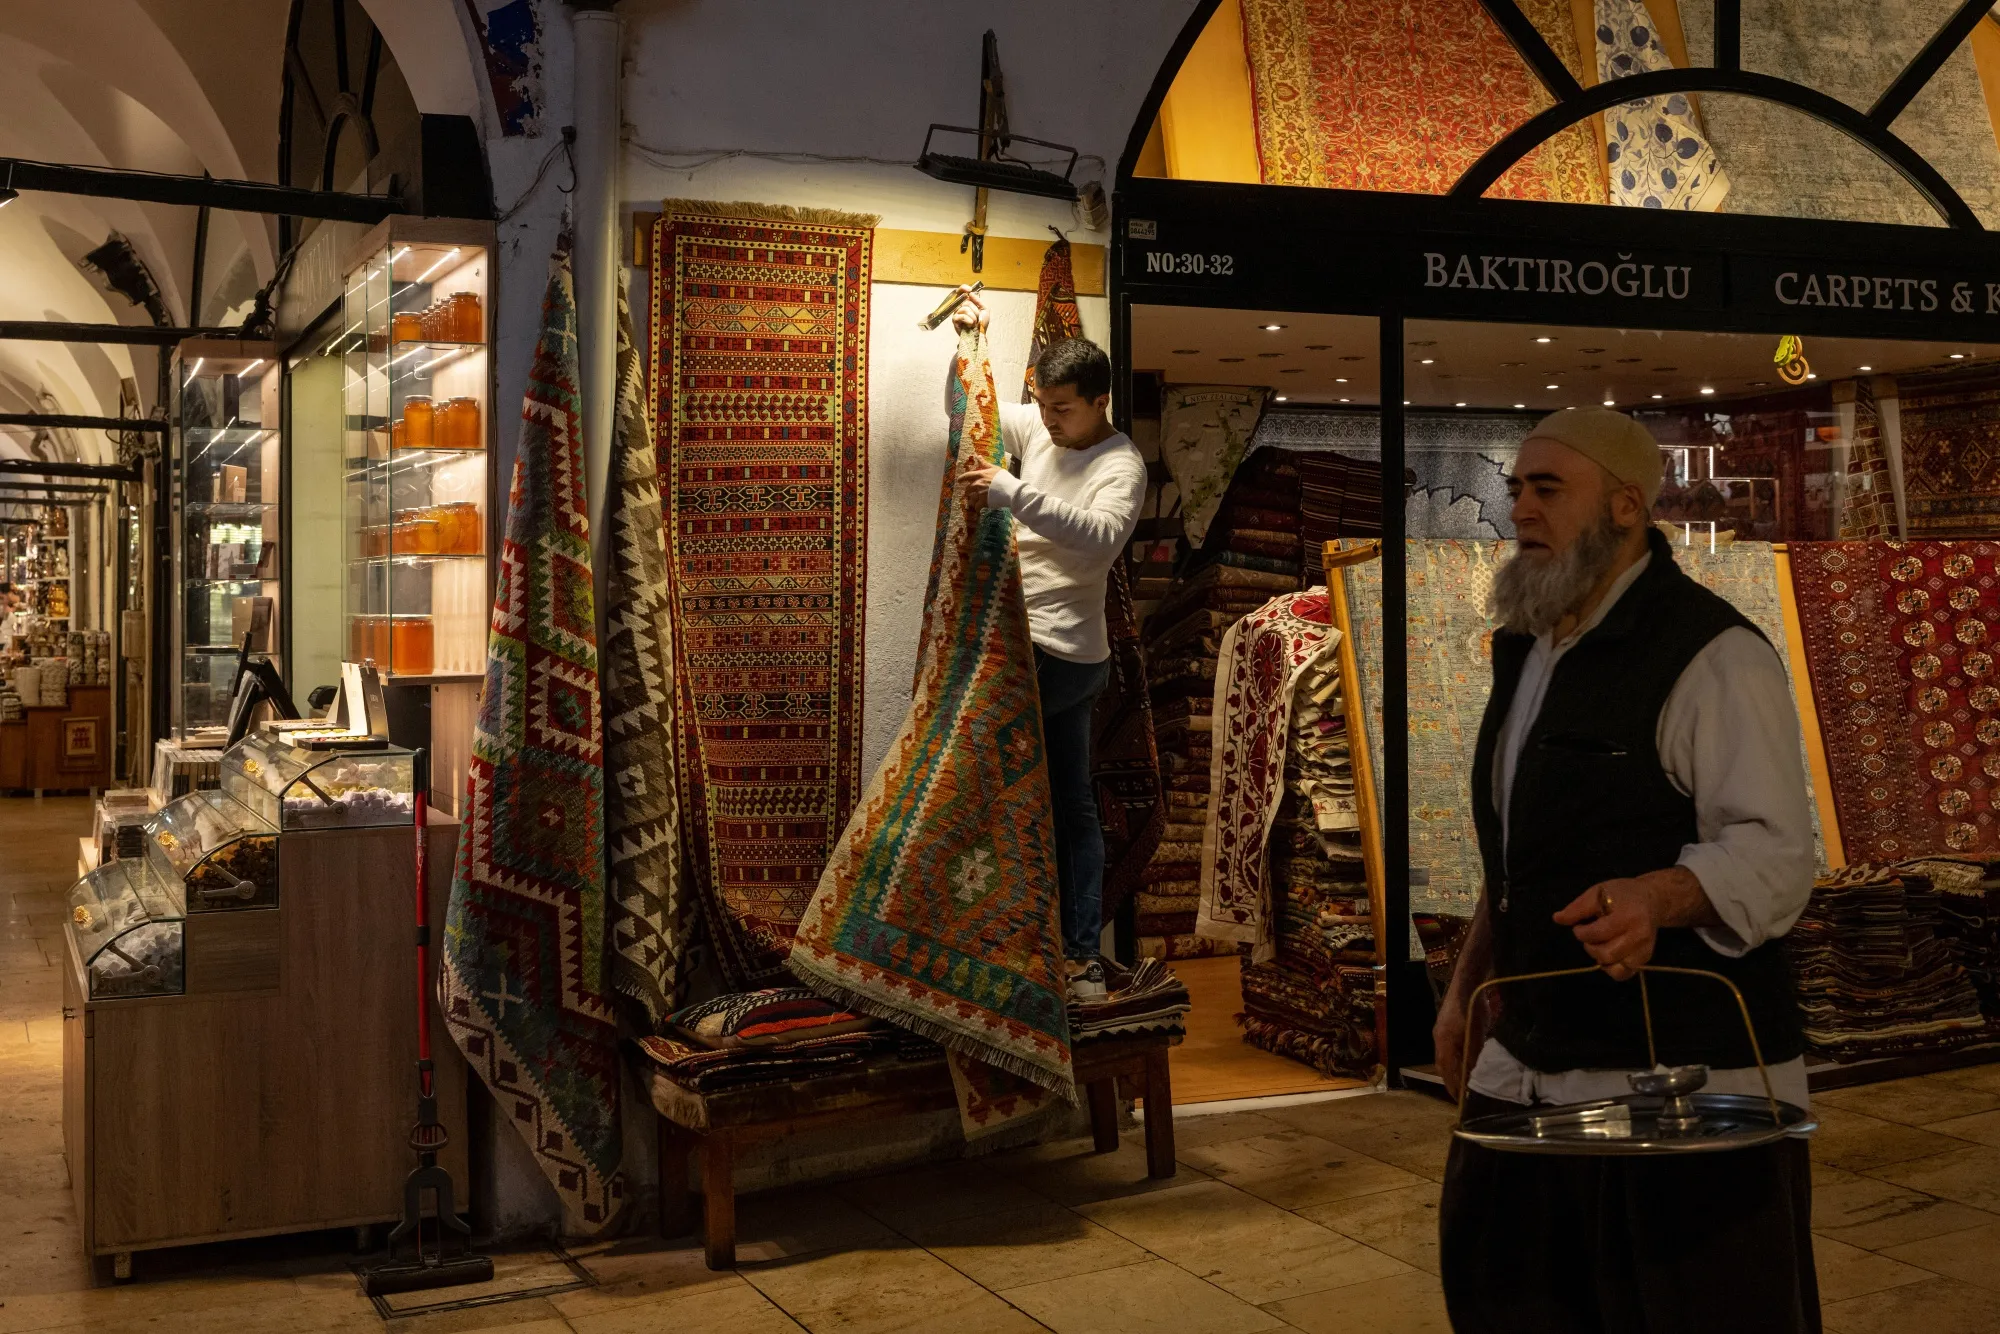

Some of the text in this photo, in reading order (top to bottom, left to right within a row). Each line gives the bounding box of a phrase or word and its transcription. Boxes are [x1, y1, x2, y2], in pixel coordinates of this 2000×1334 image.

[1146, 251, 1234, 276] NO:30-32
[1423, 251, 1692, 300] BAKTIROĞLU
[1774, 271, 1939, 312] CARPETS
[1950, 281, 1975, 314] &
[1190, 394, 1208, 402] NEW
